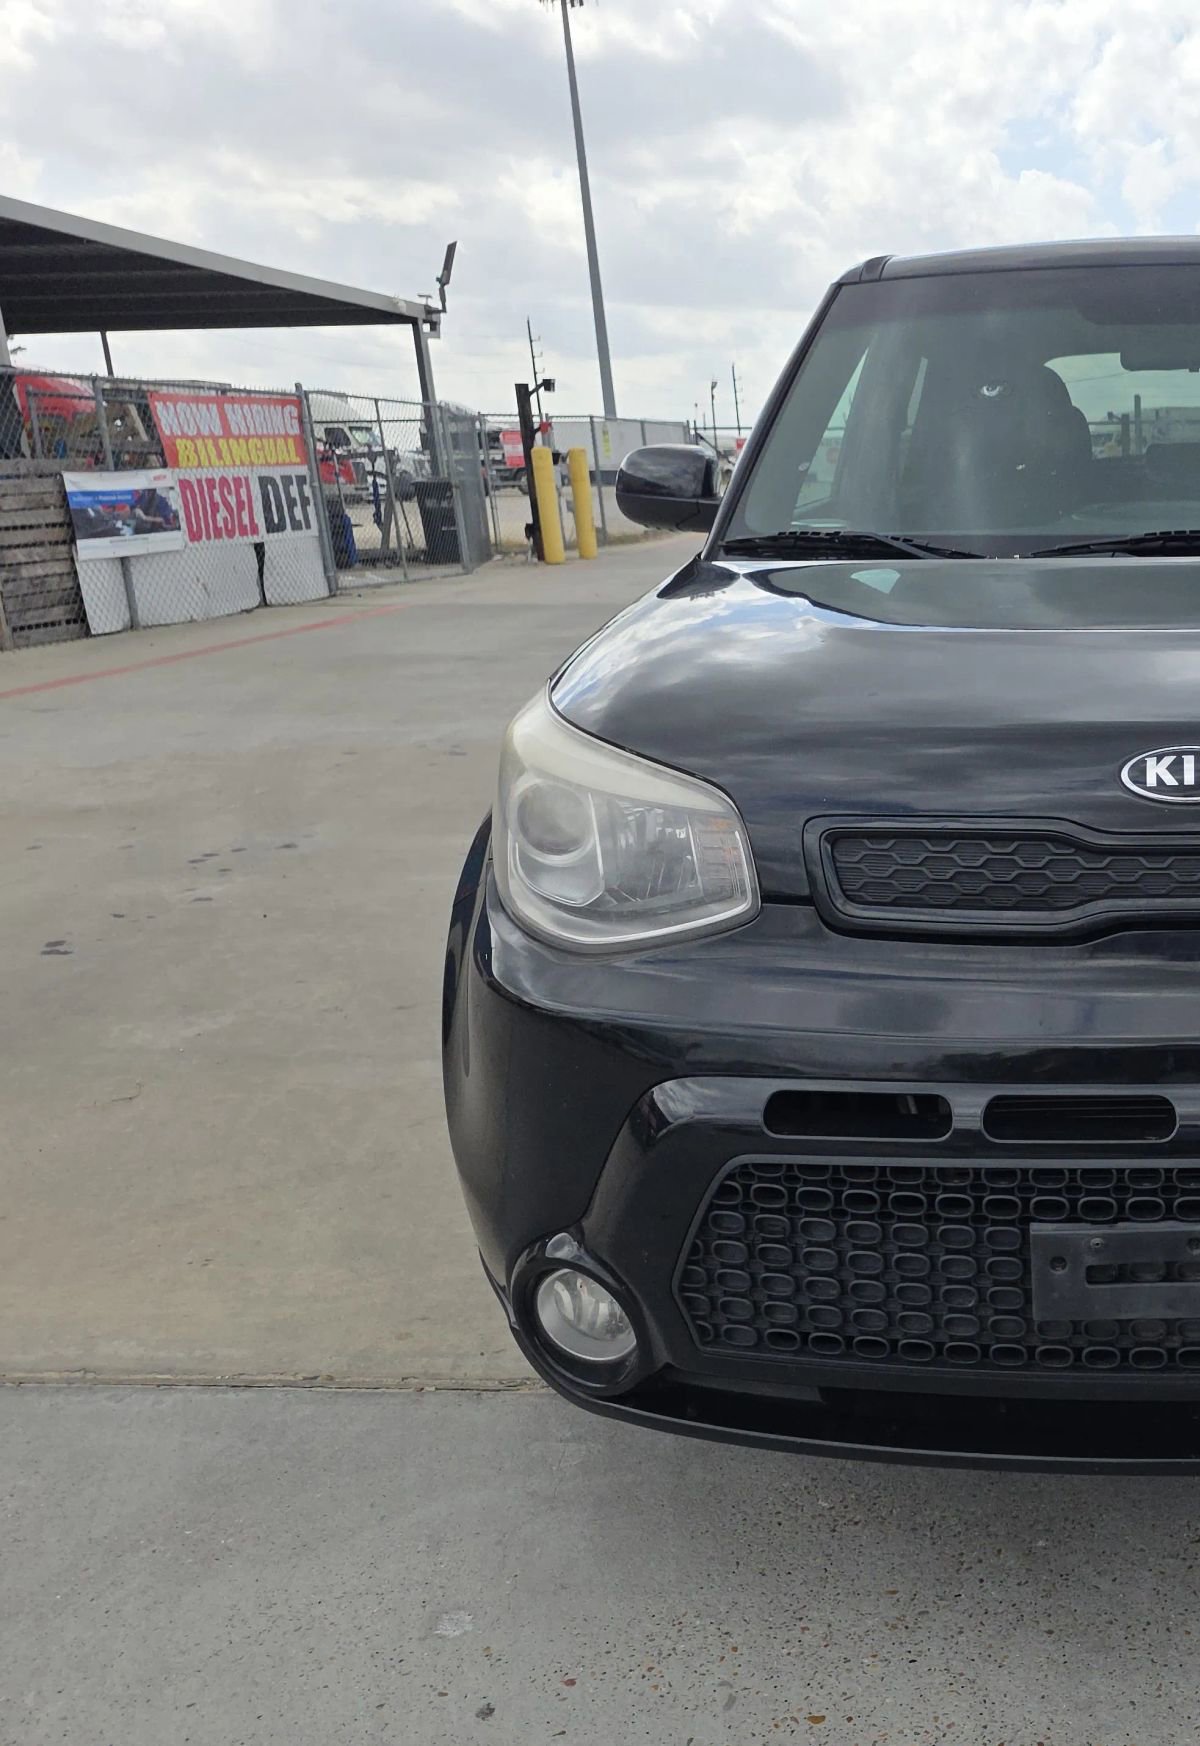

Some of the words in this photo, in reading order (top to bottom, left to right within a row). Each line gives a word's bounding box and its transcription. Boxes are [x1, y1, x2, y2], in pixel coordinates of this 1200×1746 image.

[154, 401, 223, 436] NOW
[224, 402, 300, 436] HIRING
[175, 437, 301, 468] BILINGUAL
[178, 475, 260, 543] DIESEL
[257, 475, 312, 534] DEF
